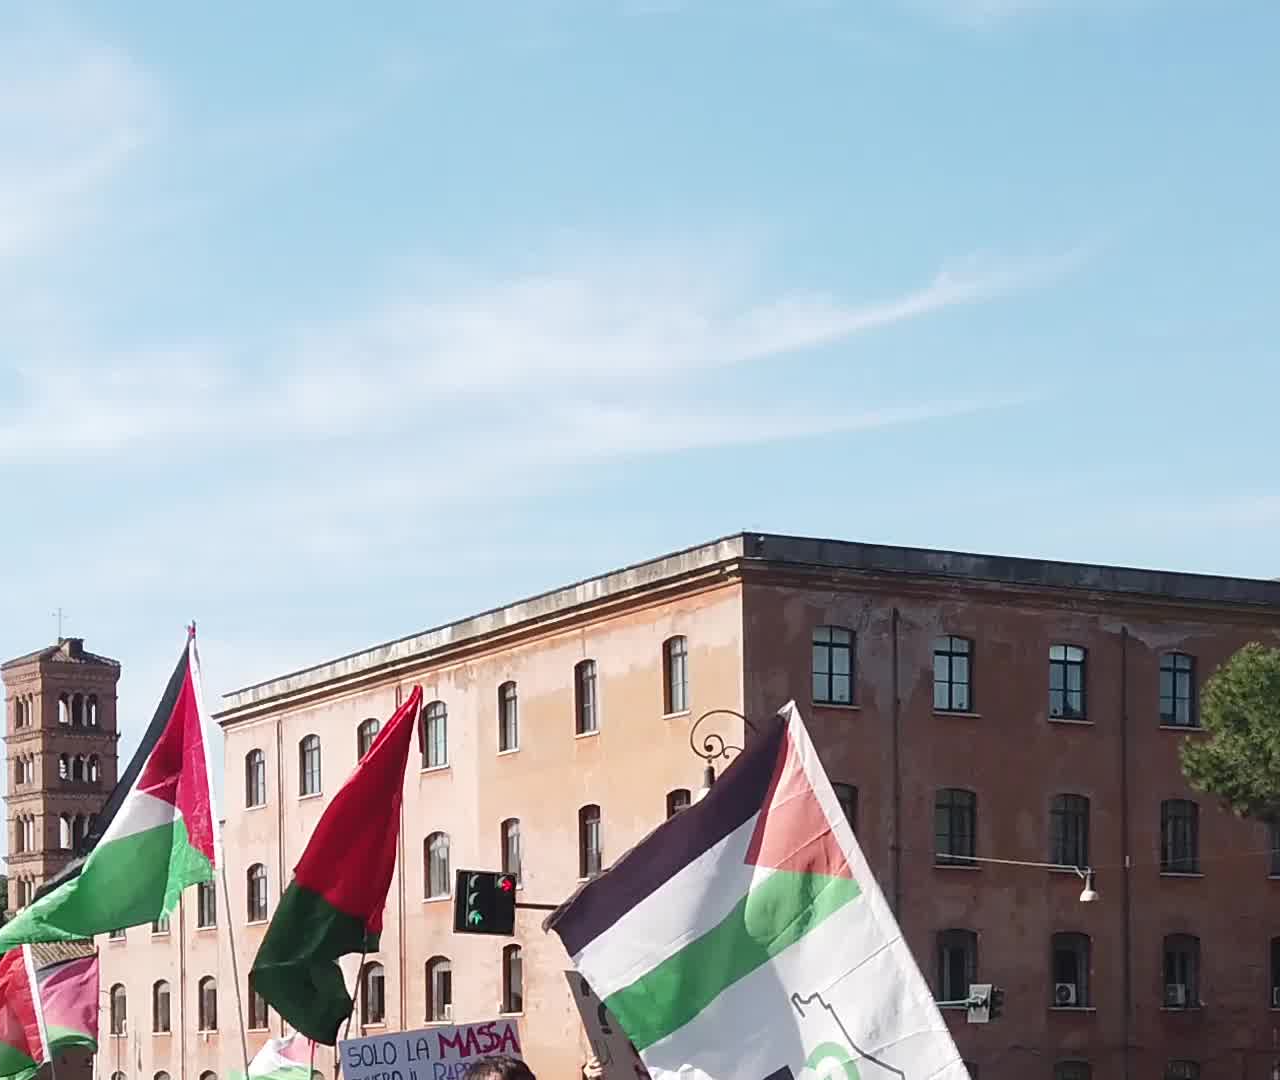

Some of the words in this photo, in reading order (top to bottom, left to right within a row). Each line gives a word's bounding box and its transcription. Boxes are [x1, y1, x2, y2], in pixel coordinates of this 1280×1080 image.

[348, 1041, 398, 1068] SOLO
[406, 1038, 430, 1062] LA
[437, 1022, 521, 1059] MASSA
